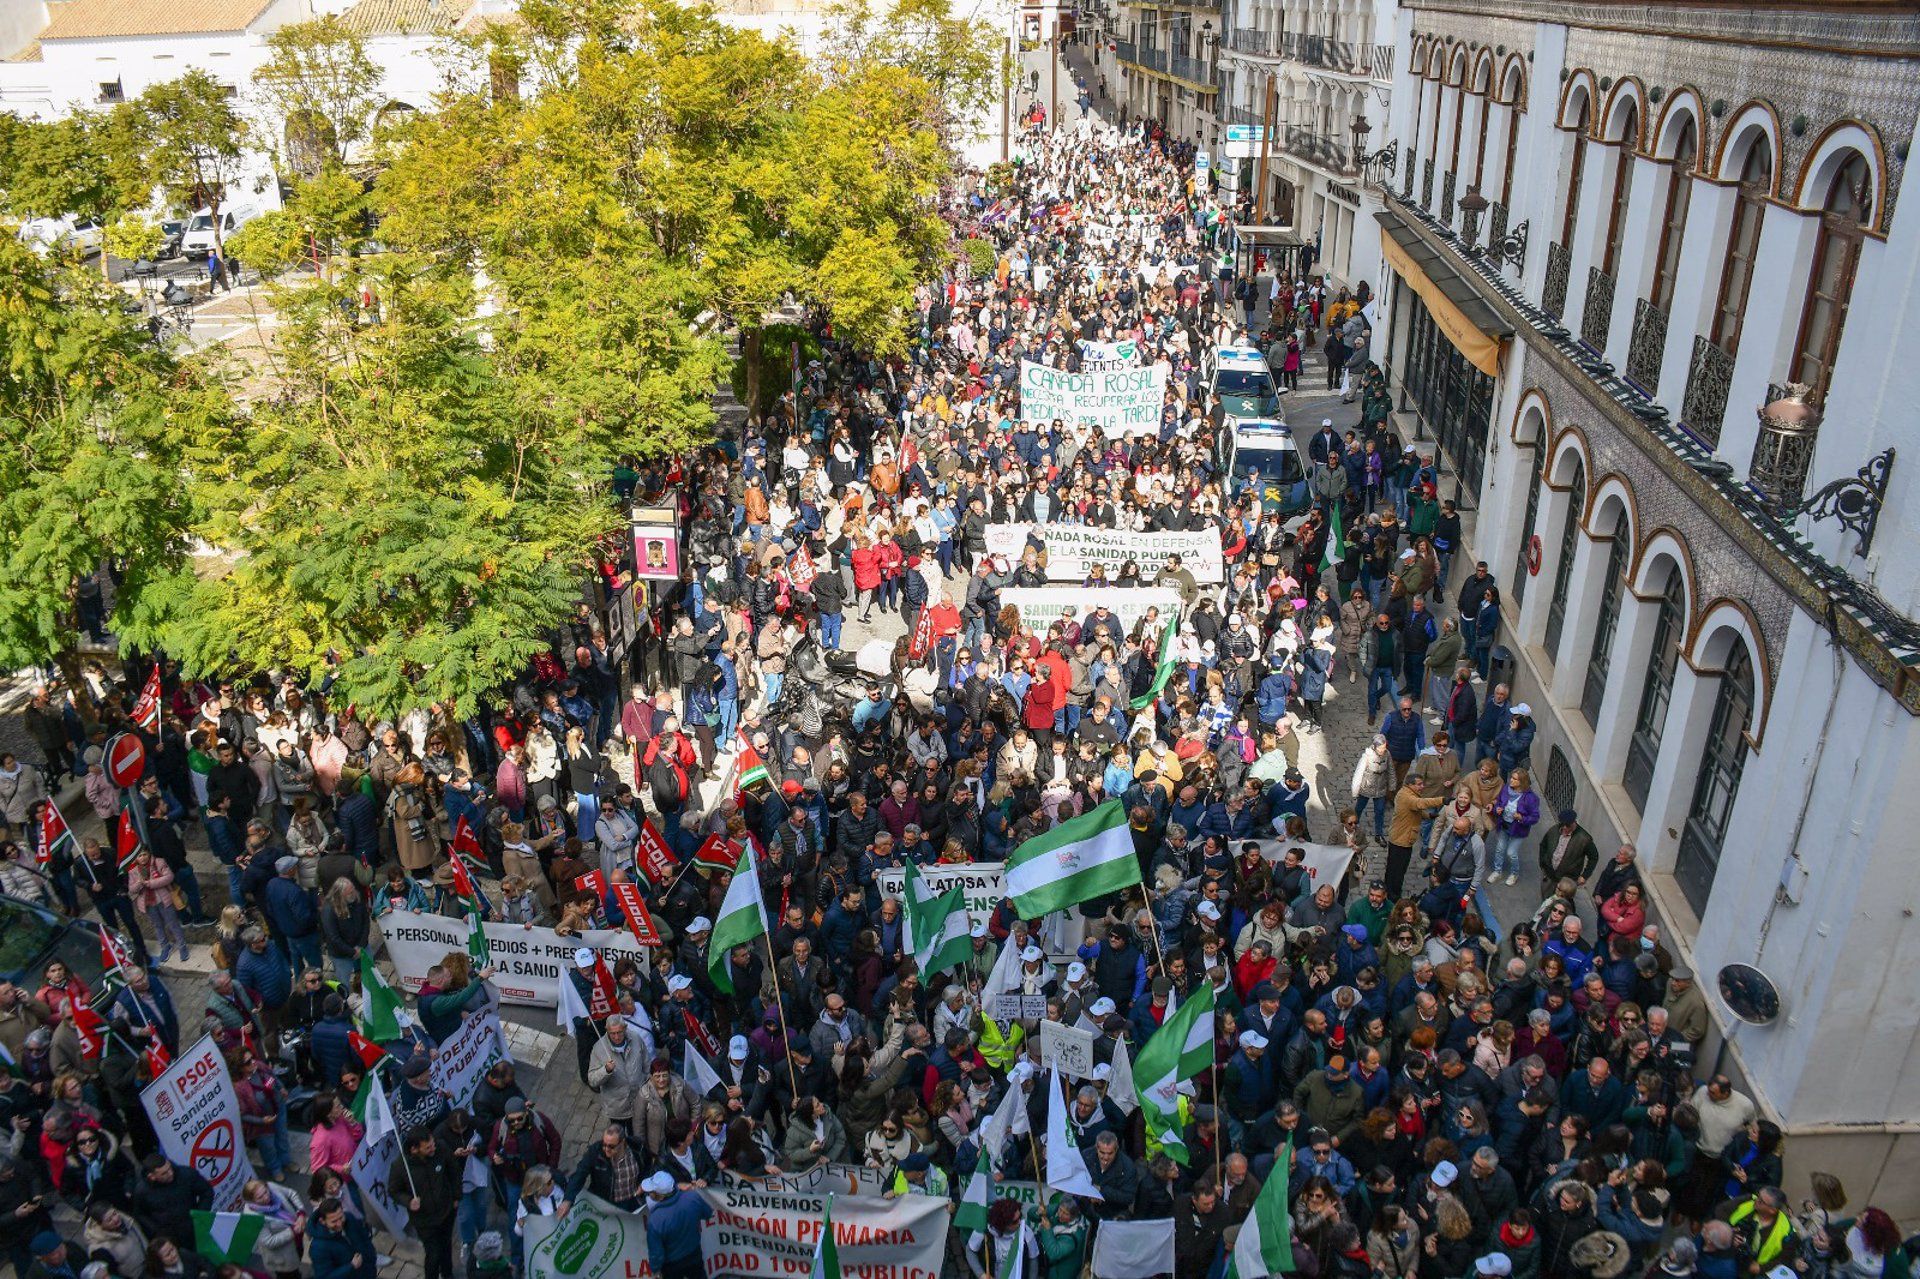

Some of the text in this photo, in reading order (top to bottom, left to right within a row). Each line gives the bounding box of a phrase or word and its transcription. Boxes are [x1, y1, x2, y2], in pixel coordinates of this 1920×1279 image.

[1140, 391, 1160, 403] LOS
[1078, 415, 1098, 427] POR
[1103, 415, 1117, 428] LA
[1122, 404, 1160, 425] TARDE
[1044, 528, 1213, 547] ÑADA ROSAL EN DEFENSA
[1061, 546, 1077, 556] LA
[1079, 547, 1138, 560] SANIDAD
[886, 875, 1000, 893] BALATOSA Y
[397, 928, 461, 947] PERSONAL
[532, 945, 541, 955] +
[513, 961, 559, 978] SANID
[441, 1008, 493, 1064] DEFENSA
[446, 1025, 494, 1080] PÚBLICA
[176, 1051, 218, 1094] PSOE
[184, 1067, 222, 1101] MARCHENA
[171, 1081, 222, 1132] Sanidad
[180, 1100, 226, 1146] Pública
[764, 1177, 799, 1192] EN
[808, 1164, 888, 1188] DEFEN
[727, 1191, 823, 1213] SALVEMOS
[705, 1210, 916, 1247] ENCIÓN PRMARIA
[718, 1232, 815, 1258] DEFENDAM
[706, 1252, 759, 1275] IDAD
[770, 1255, 812, 1274] 100
